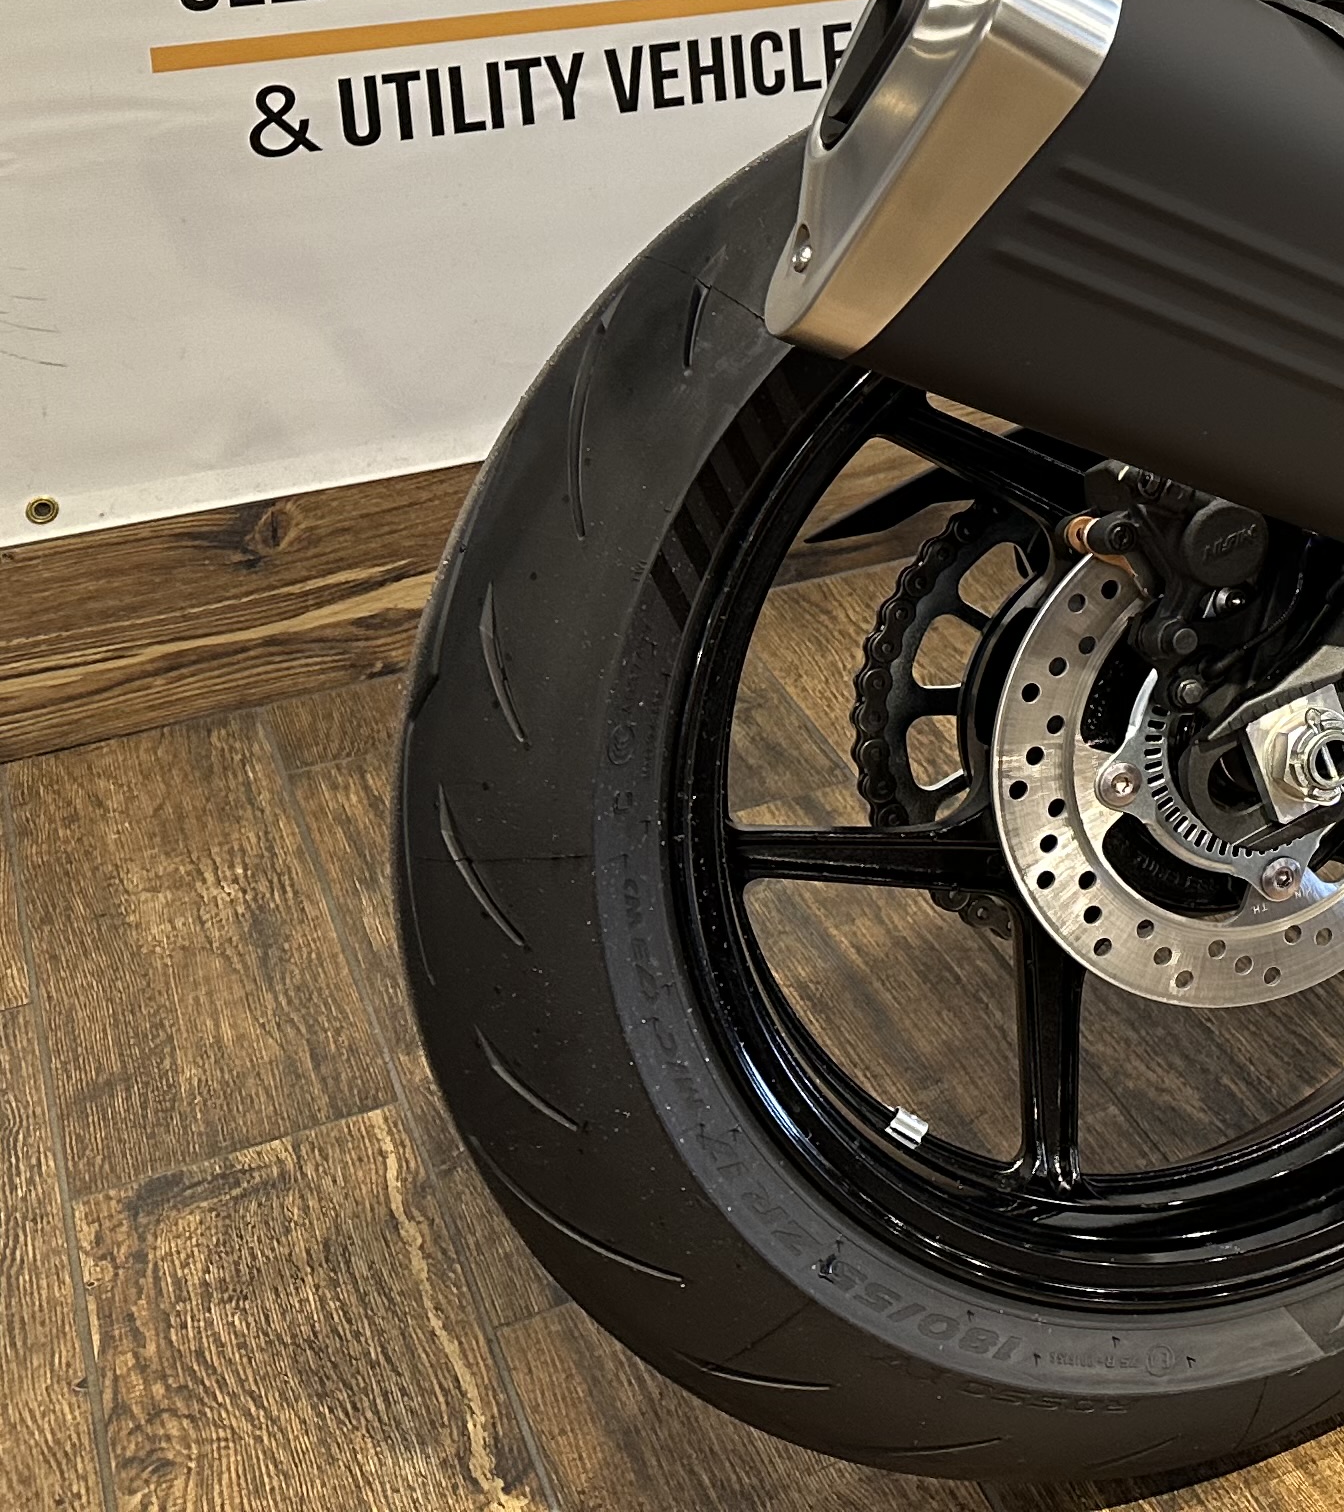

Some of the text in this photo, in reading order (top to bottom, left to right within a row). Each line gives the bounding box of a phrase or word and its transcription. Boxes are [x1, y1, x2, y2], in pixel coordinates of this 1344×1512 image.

[250, 23, 853, 157] & UTILITY VEHICLE
